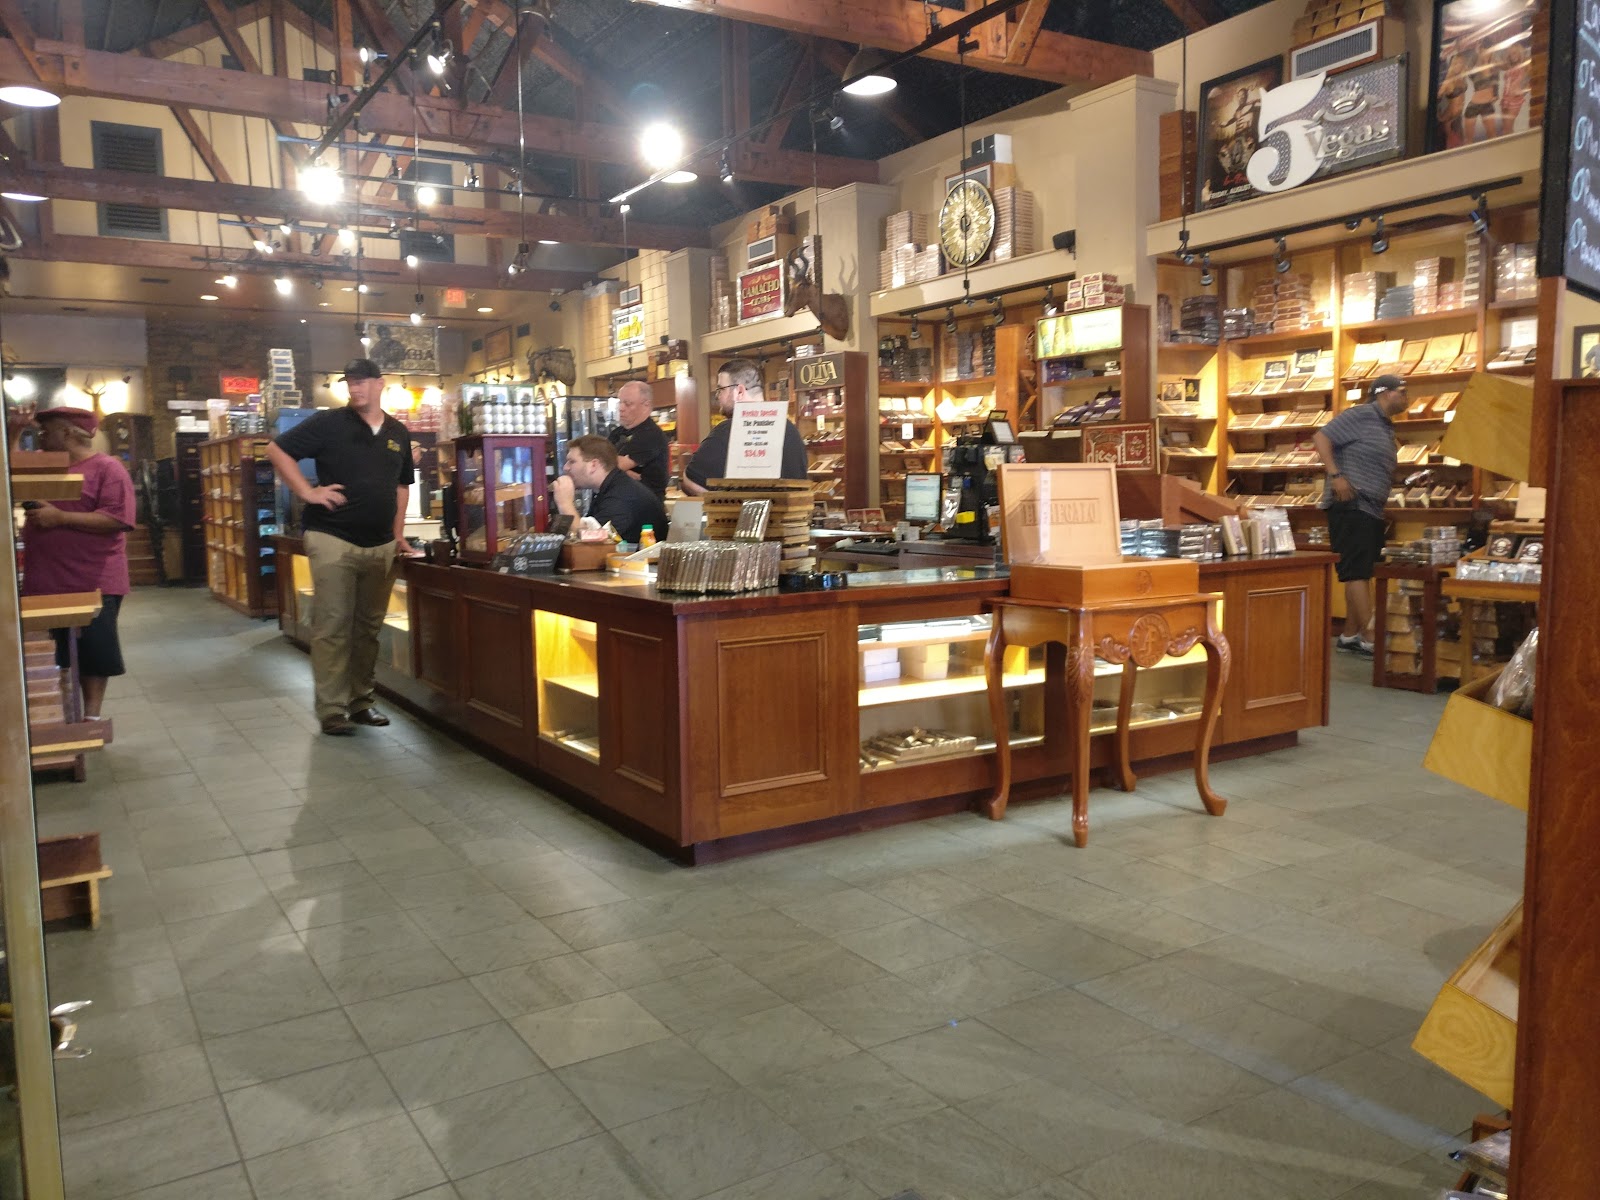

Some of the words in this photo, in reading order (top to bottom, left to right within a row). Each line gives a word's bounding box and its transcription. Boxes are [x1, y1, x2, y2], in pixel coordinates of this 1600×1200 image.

[1246, 71, 1327, 192] 5
[1303, 120, 1390, 160] Vegas
[742, 279, 780, 299] CAMACHO
[800, 360, 838, 385] OLIVA
